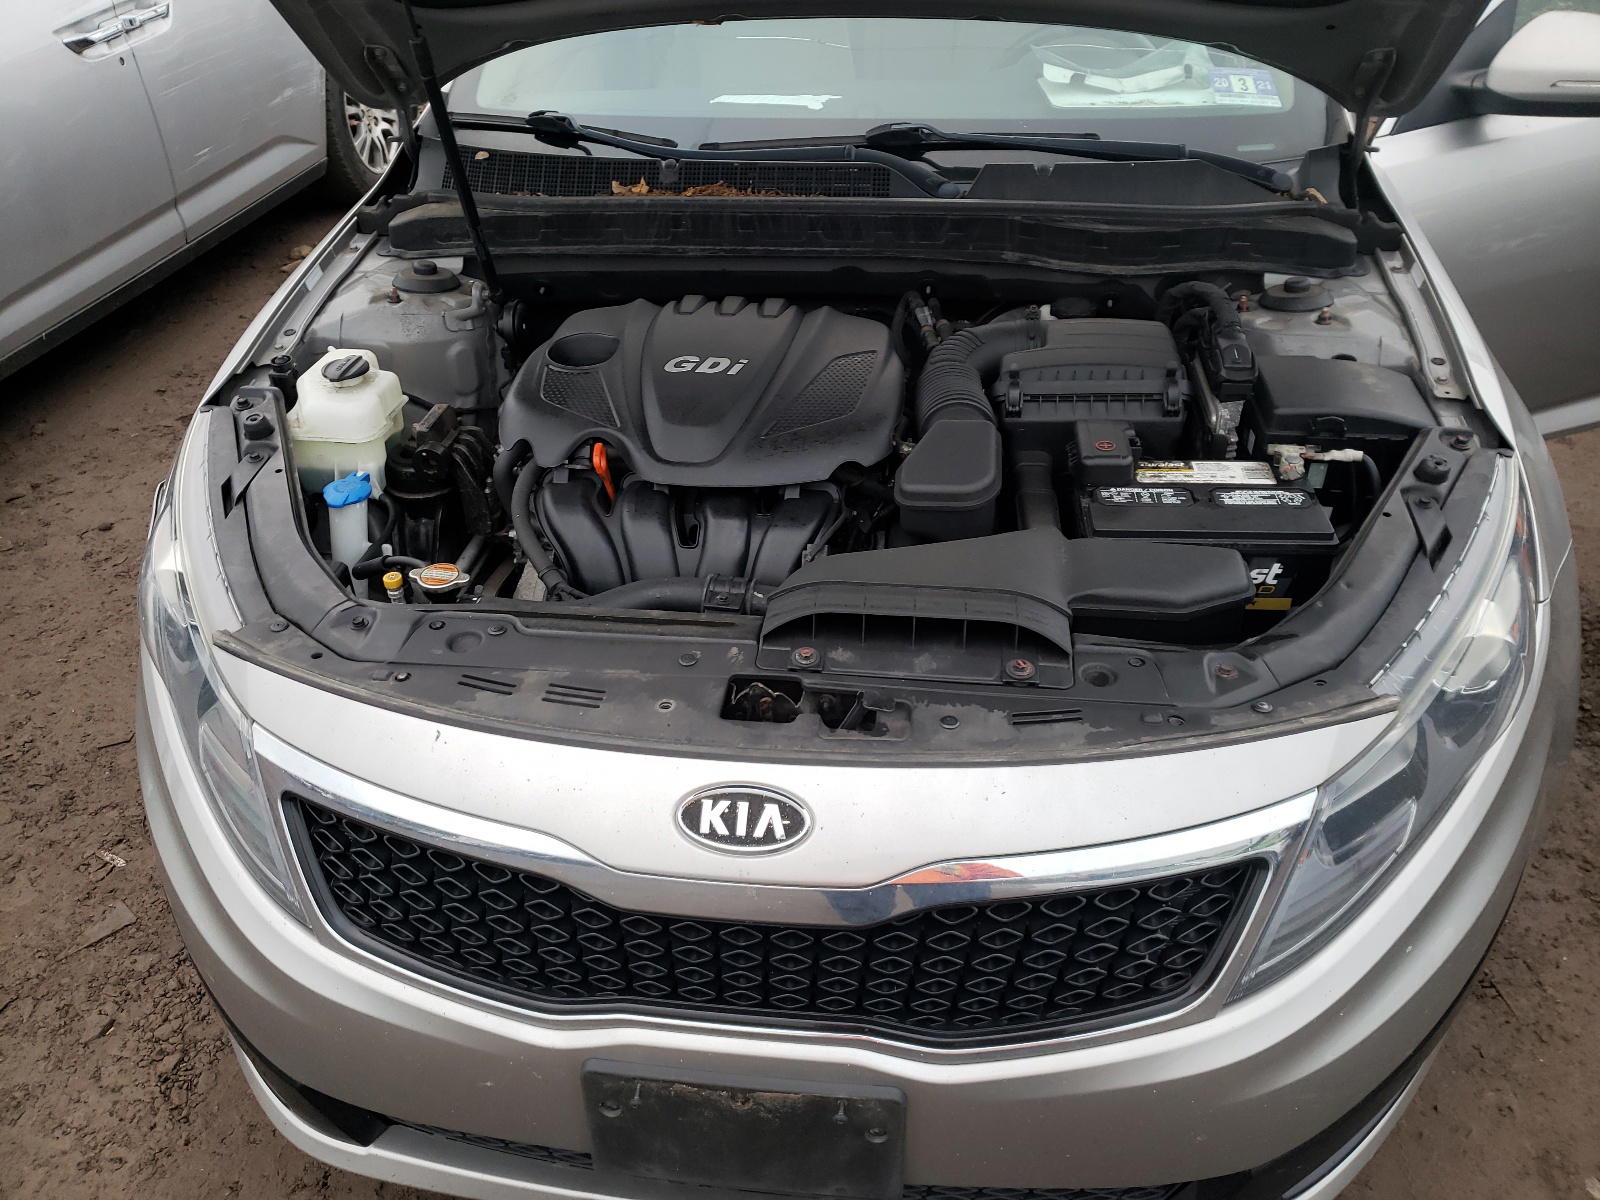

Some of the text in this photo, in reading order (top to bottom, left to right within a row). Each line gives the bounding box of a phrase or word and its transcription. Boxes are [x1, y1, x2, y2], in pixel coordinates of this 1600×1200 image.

[1213, 77, 1229, 88] 20
[1238, 77, 1249, 92] 3
[663, 355, 749, 375] GDi
[700, 799, 787, 840] KIA
